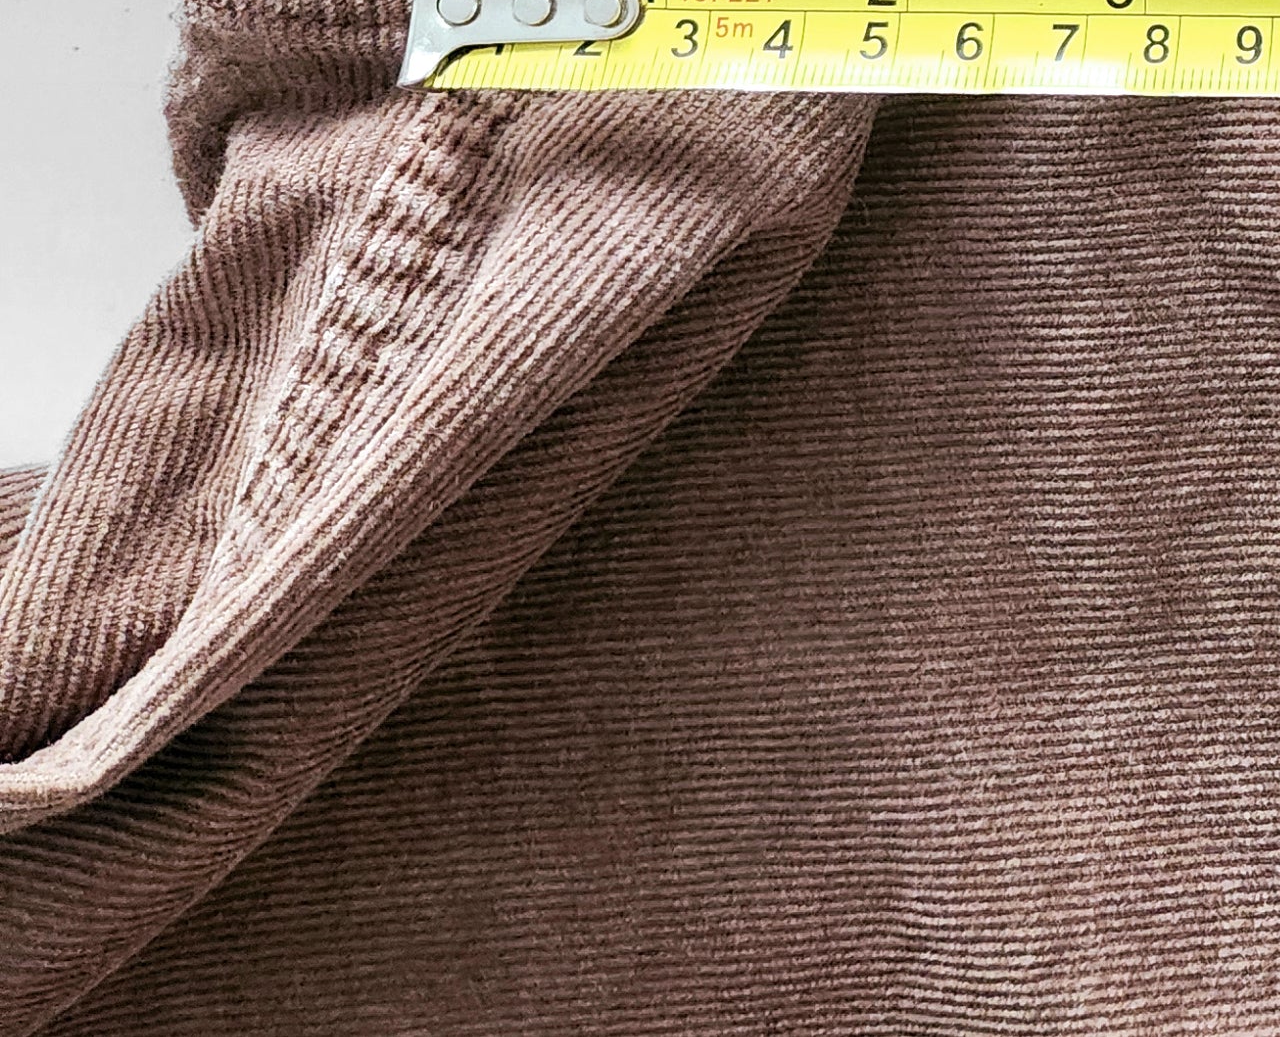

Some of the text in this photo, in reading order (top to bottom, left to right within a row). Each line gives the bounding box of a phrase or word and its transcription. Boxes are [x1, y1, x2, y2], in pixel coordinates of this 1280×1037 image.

[671, 19, 699, 57] 3
[763, 21, 793, 59] 4
[860, 22, 889, 60] 5
[956, 22, 984, 61] 6
[1052, 24, 1079, 62] 7
[1143, 25, 1170, 63] 8
[1236, 26, 1263, 65] 9
[716, 17, 753, 38] 5m
